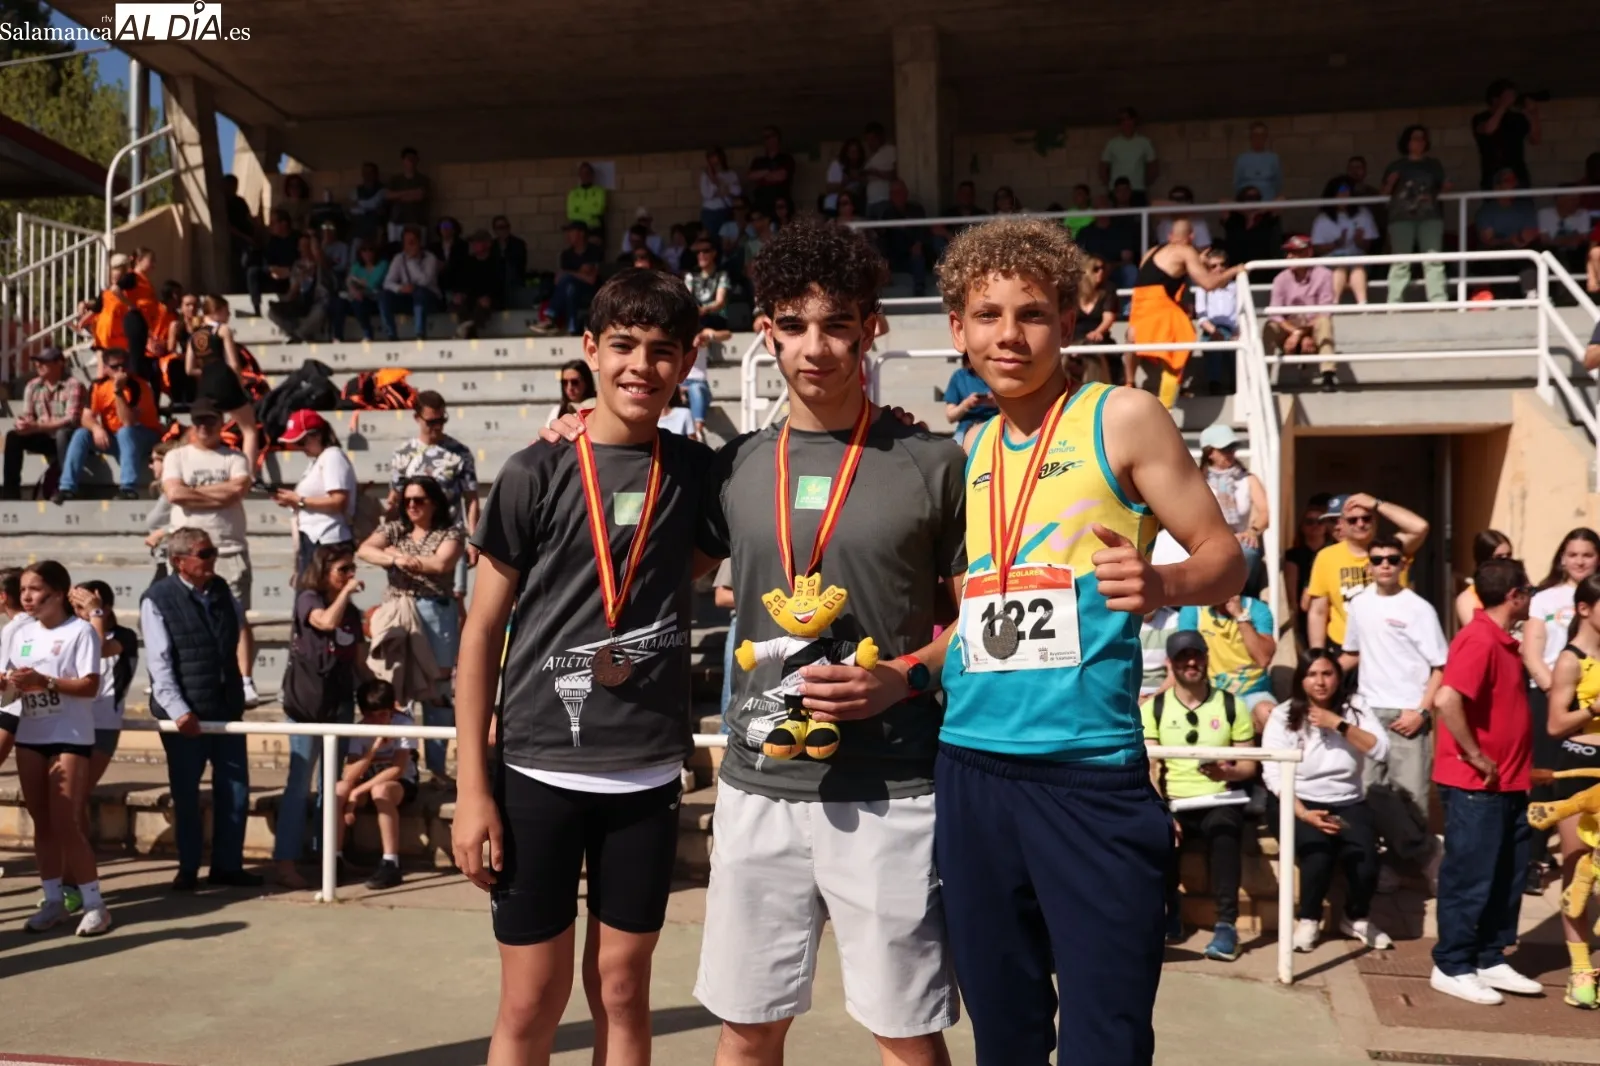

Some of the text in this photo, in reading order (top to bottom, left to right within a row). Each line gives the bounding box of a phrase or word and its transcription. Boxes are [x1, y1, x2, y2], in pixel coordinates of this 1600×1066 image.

[981, 597, 1056, 641] 122
[542, 655, 593, 671] ATLÉTIC
[1561, 740, 1597, 756] PRO
